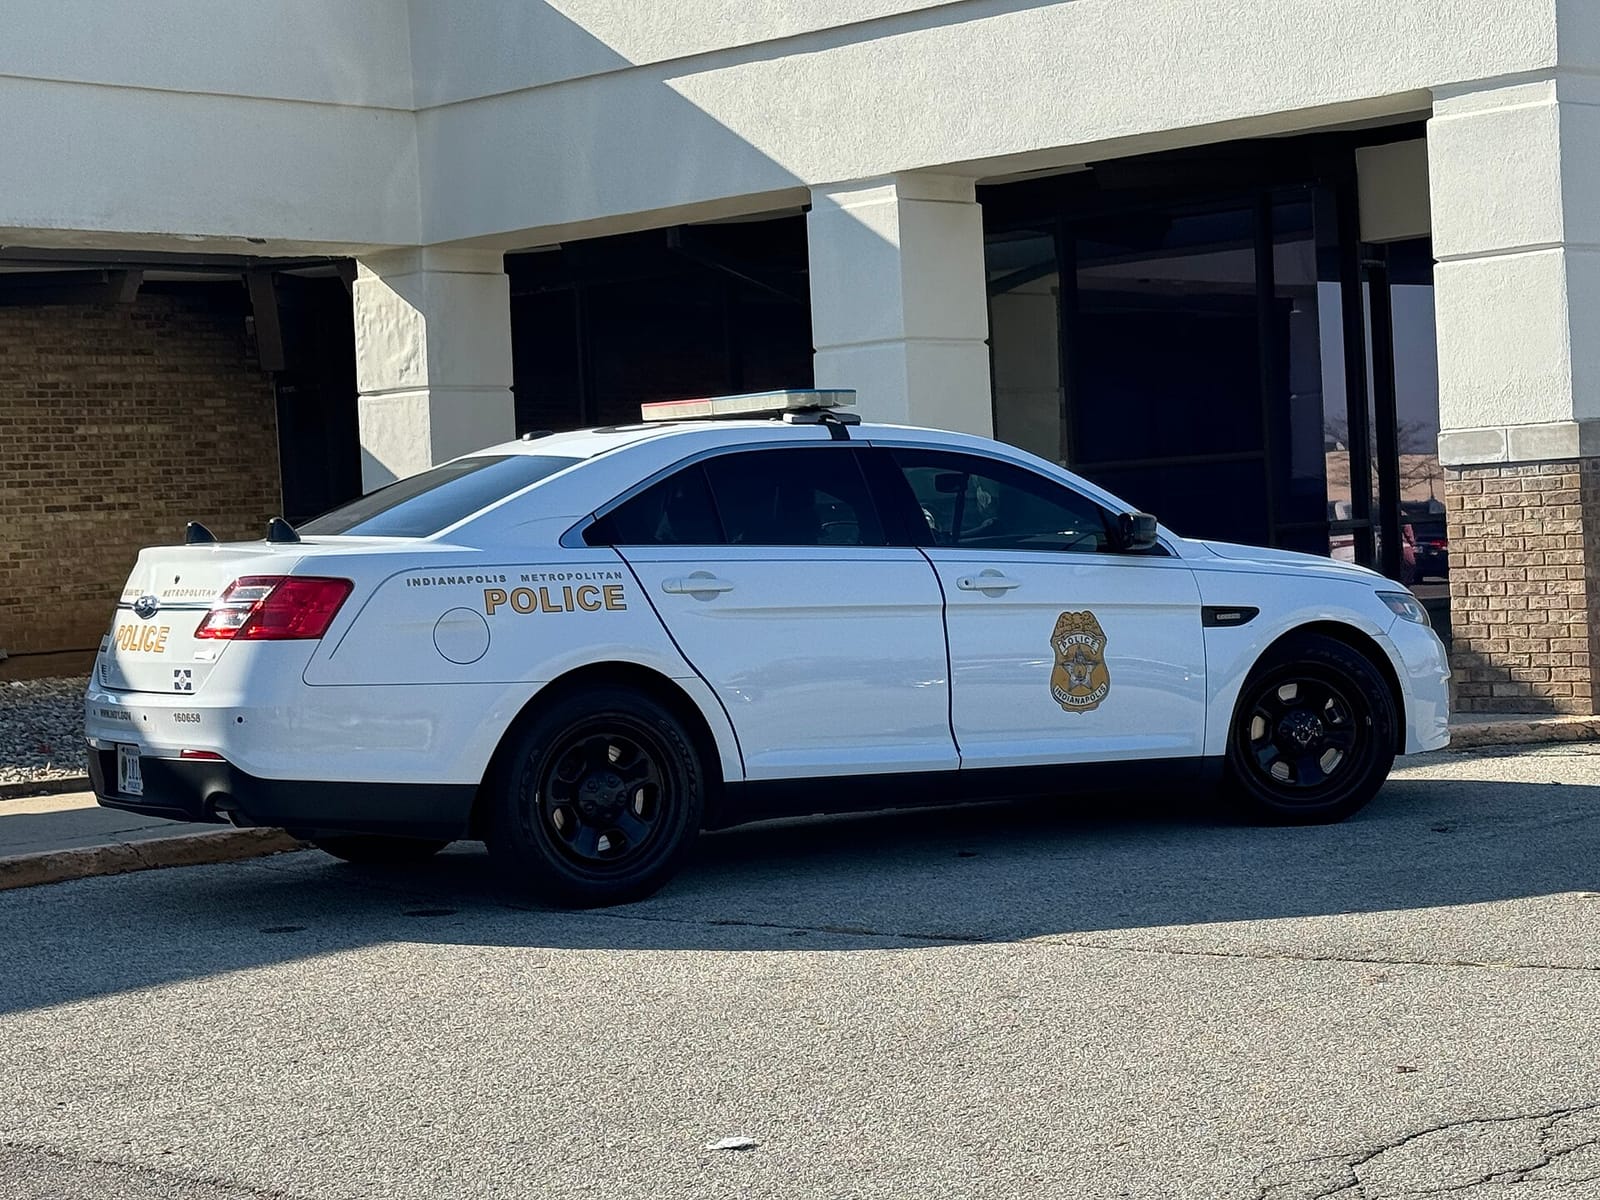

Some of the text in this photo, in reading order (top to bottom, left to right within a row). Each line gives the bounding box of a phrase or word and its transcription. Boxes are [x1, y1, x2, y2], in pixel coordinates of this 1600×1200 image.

[406, 571, 623, 587] INDIANAPOLIS METROPOLITAN
[483, 584, 628, 616] POLICE
[115, 624, 171, 654] POLICE
[1061, 635, 1097, 649] POLICE
[1054, 685, 1106, 705] INDIANAPOLIS
[173, 712, 201, 724] 160658
